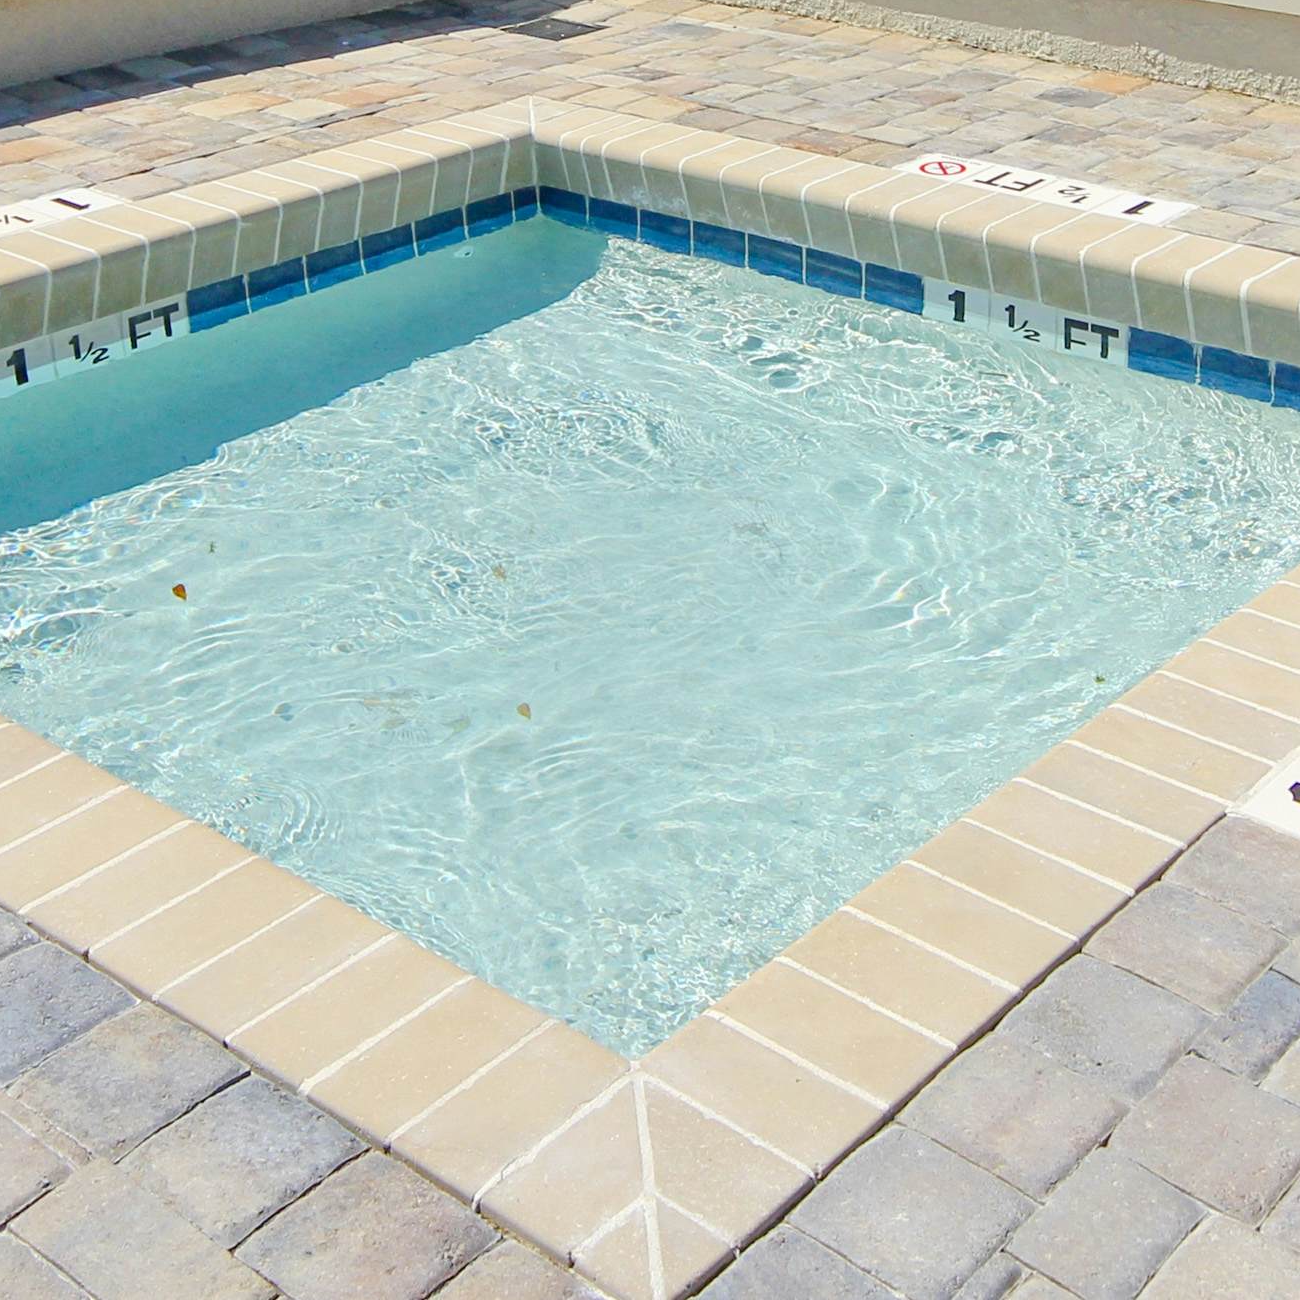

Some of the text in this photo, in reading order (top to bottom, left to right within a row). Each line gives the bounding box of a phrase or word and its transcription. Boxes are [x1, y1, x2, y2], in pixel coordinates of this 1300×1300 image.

[973, 171, 1046, 192] FT
[50, 197, 92, 211] 1
[1122, 200, 1155, 216] 1
[947, 289, 967, 323] 1
[1063, 316, 1120, 360] FT
[5, 348, 30, 387] 1
[127, 301, 180, 350] FT
